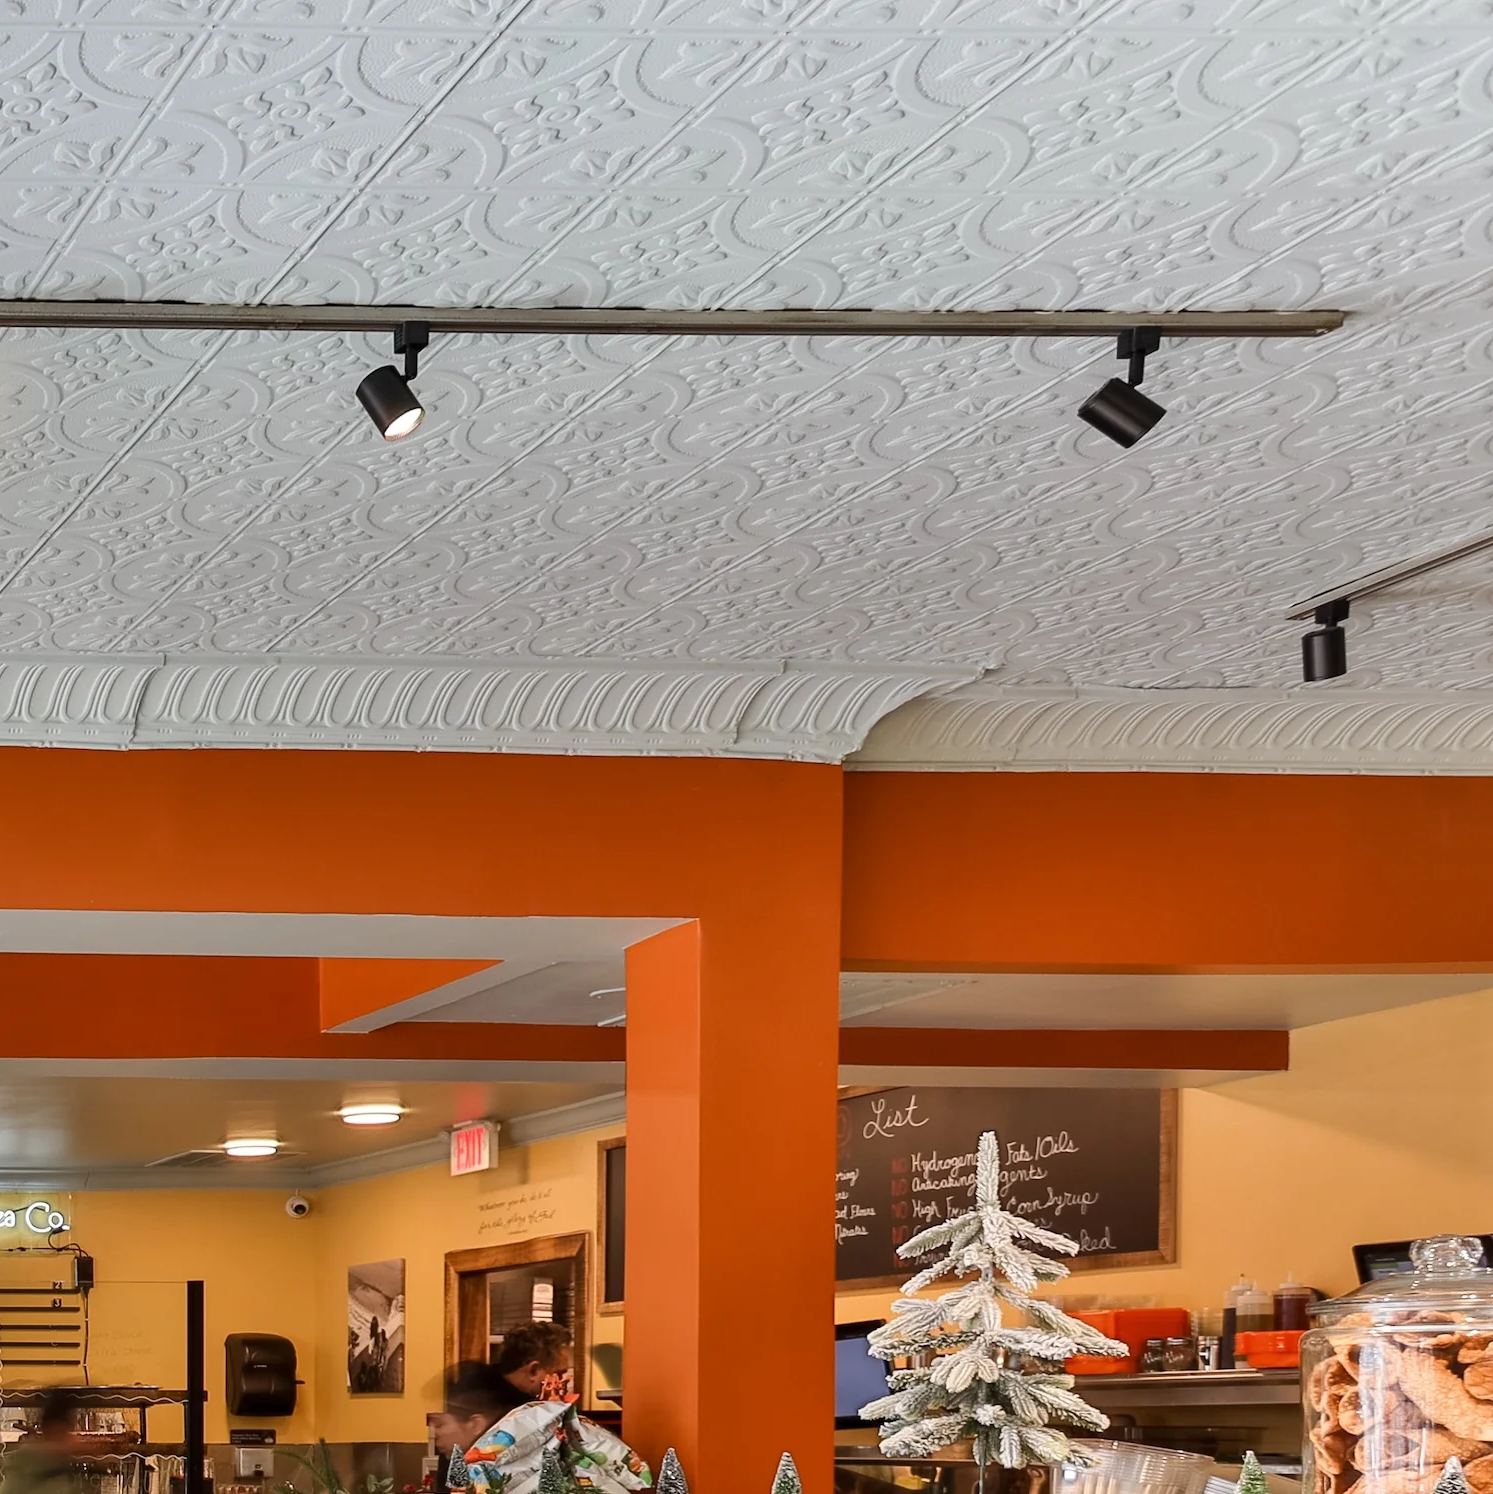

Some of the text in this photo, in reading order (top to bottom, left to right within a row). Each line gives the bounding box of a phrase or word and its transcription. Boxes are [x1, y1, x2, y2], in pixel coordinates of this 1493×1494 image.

[863, 1095, 930, 1140] List
[456, 1126, 485, 1172] EXIT
[999, 1164, 1048, 1198] gents
[24, 1201, 70, 1233] Co.
[912, 1199, 942, 1223] High
[55, 1299, 61, 1307] 3
